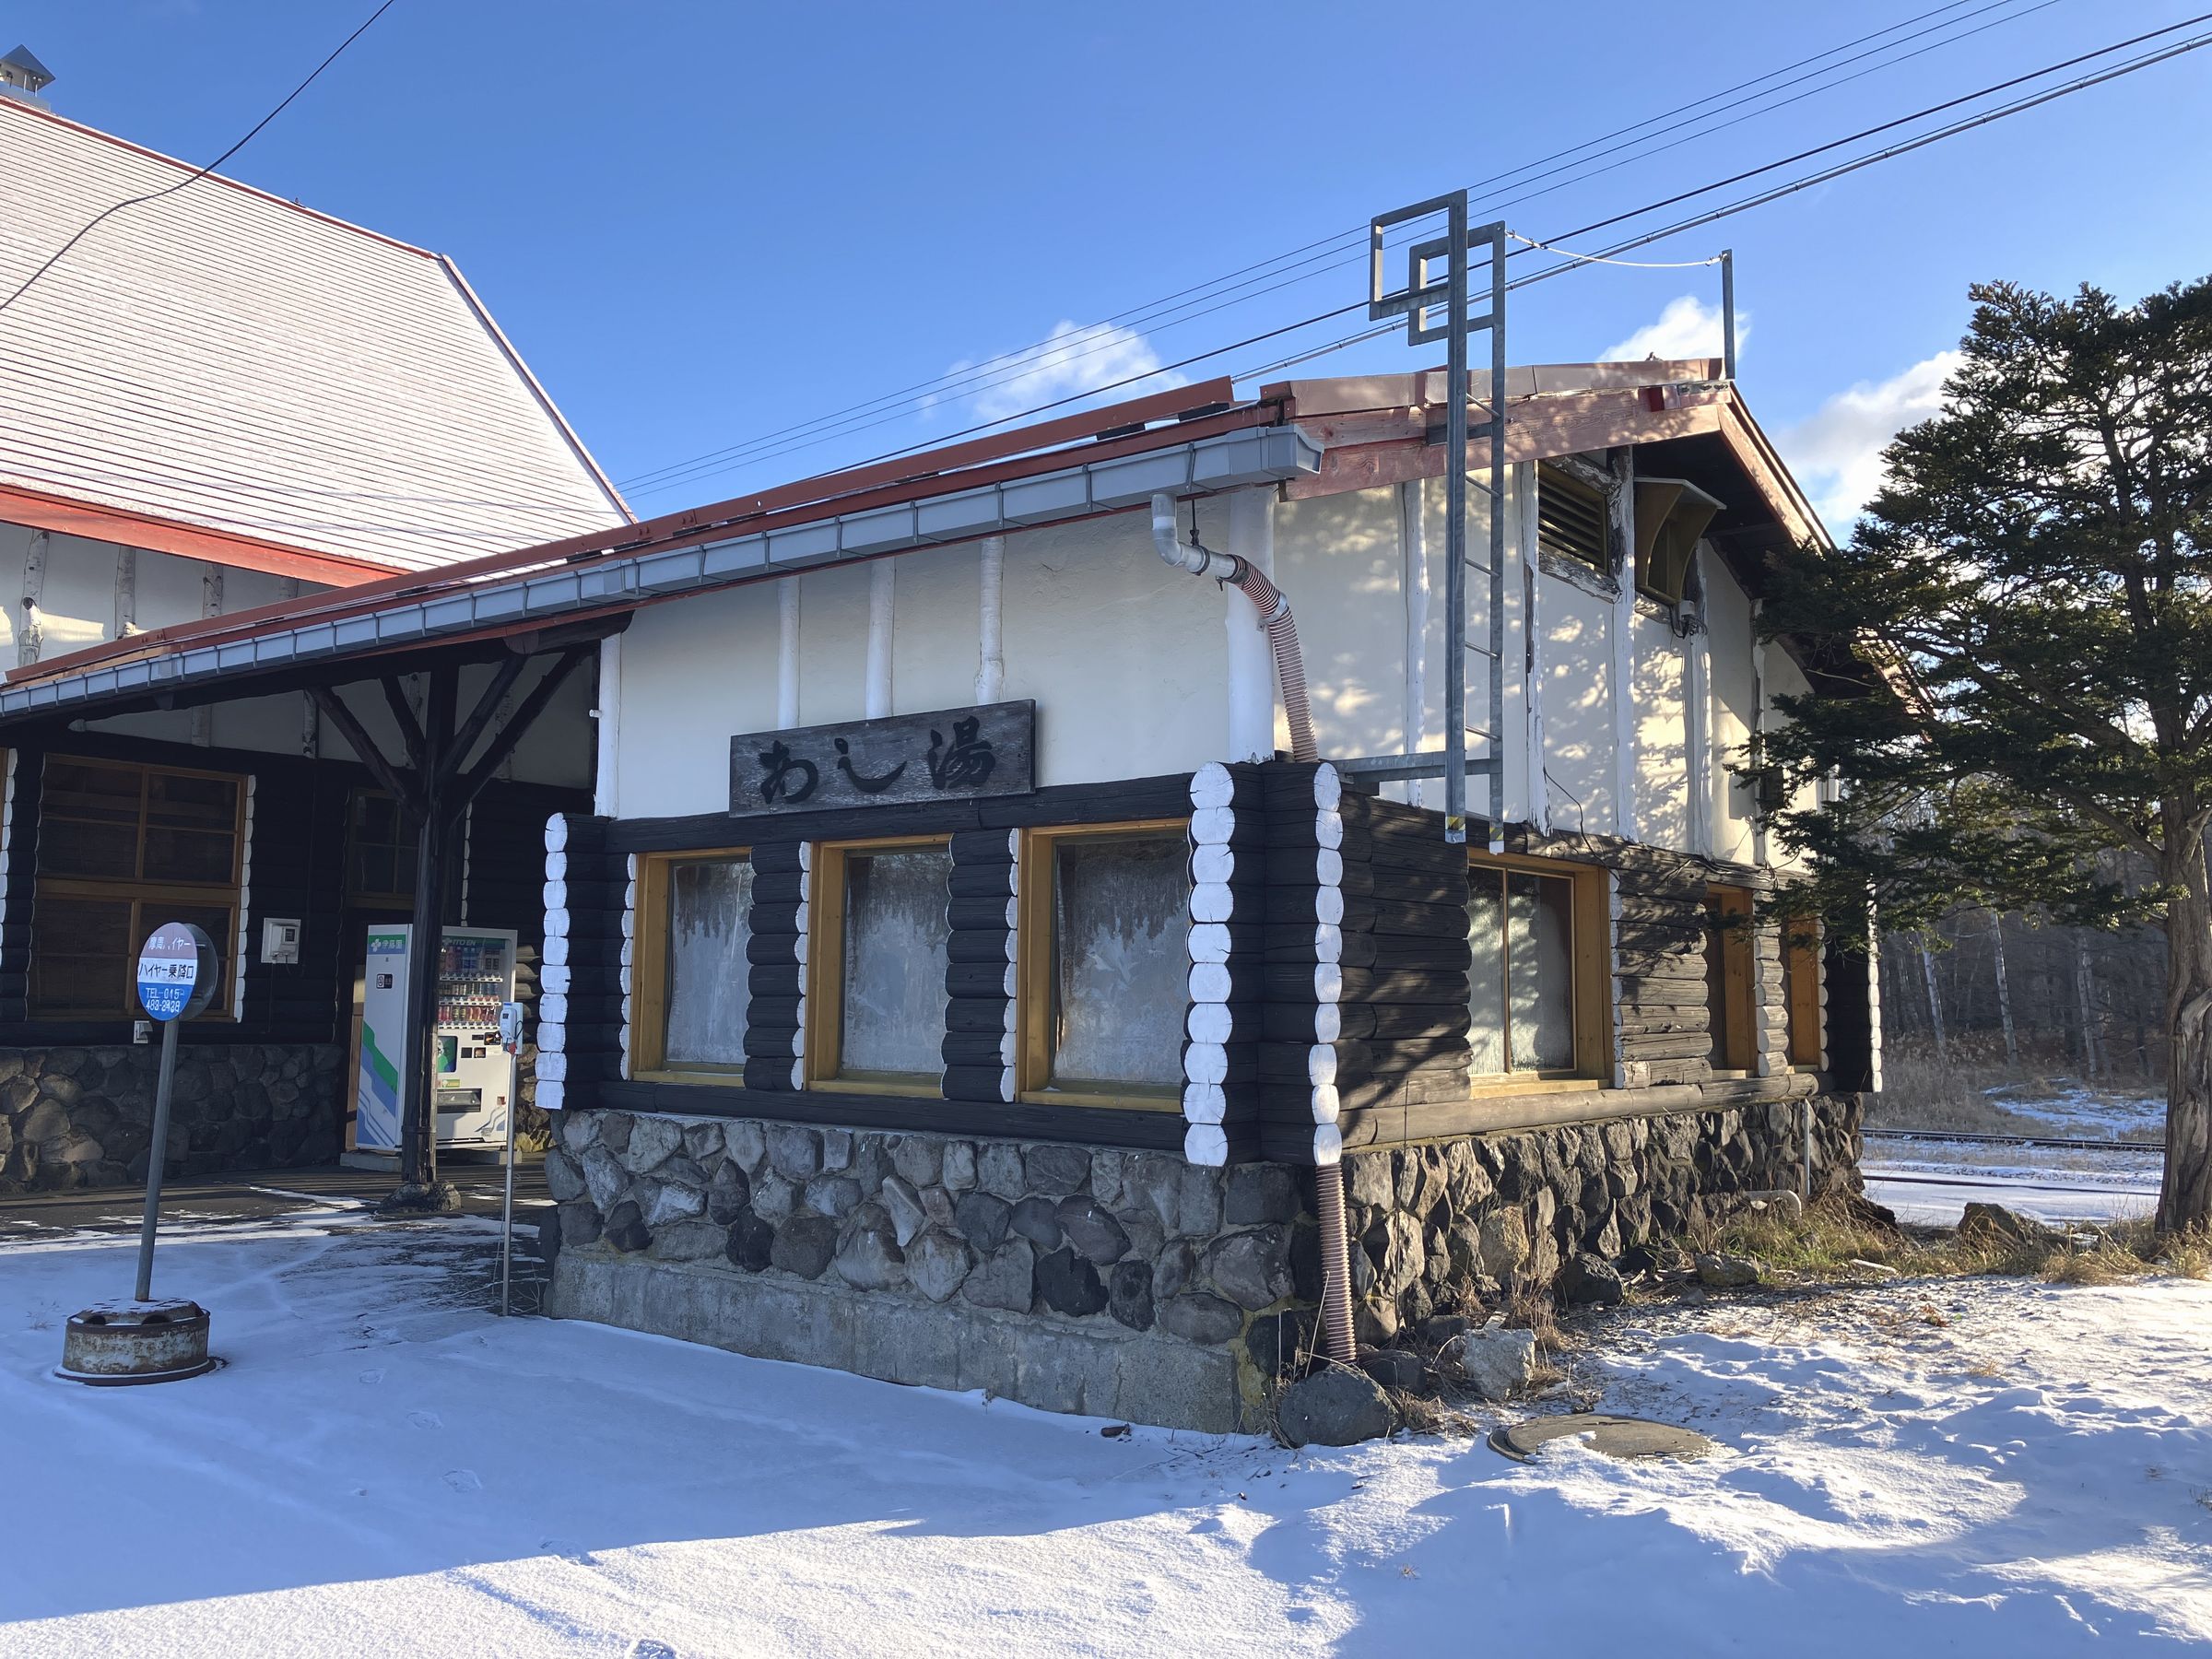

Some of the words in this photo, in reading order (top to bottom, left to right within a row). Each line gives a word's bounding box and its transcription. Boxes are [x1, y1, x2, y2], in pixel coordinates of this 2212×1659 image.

[758, 714, 997, 806] あし湯
[138, 963, 194, 979] ハイヤー乗降口
